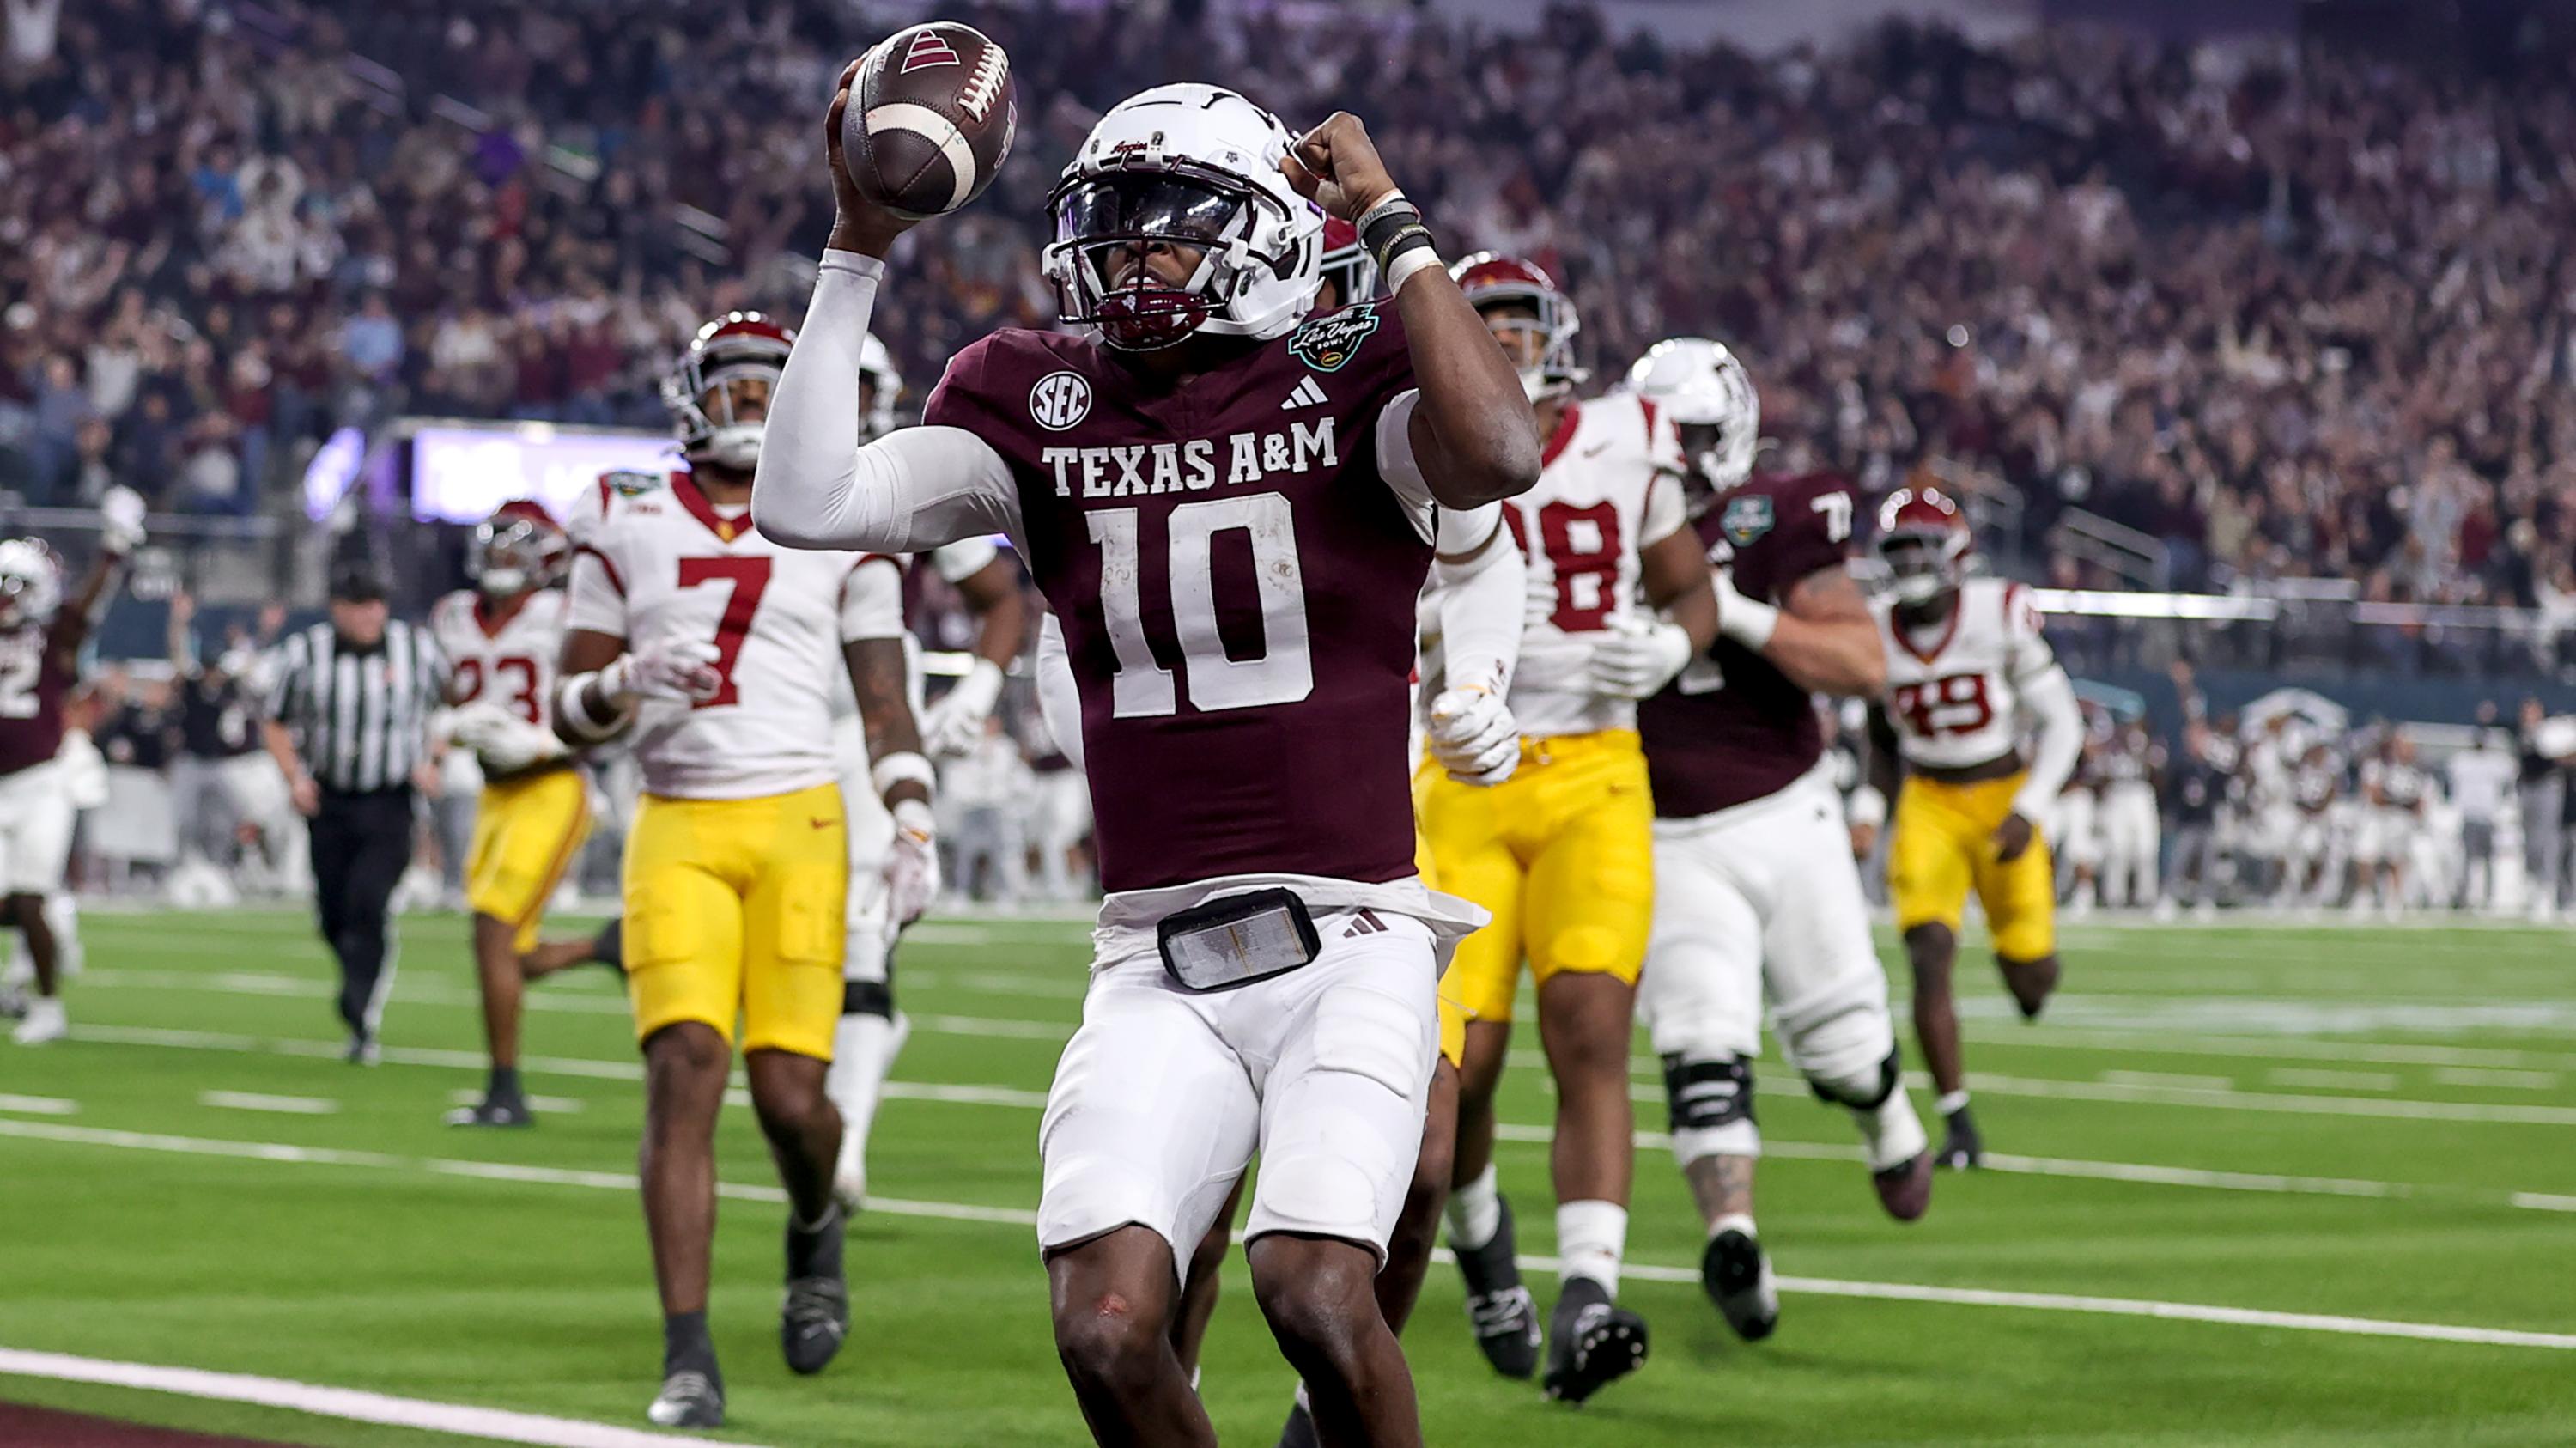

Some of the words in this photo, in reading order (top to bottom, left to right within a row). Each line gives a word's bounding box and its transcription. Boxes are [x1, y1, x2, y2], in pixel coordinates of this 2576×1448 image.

[1292, 327, 1326, 349] Las
[1327, 321, 1373, 340] Vegas
[1317, 338, 1344, 350] BOWL
[1035, 375, 1087, 427] SEC
[1042, 438, 1215, 498] TEXAS
[1228, 417, 1338, 484] A&M
[677, 556, 772, 709] 7
[1084, 491, 1314, 719] 10
